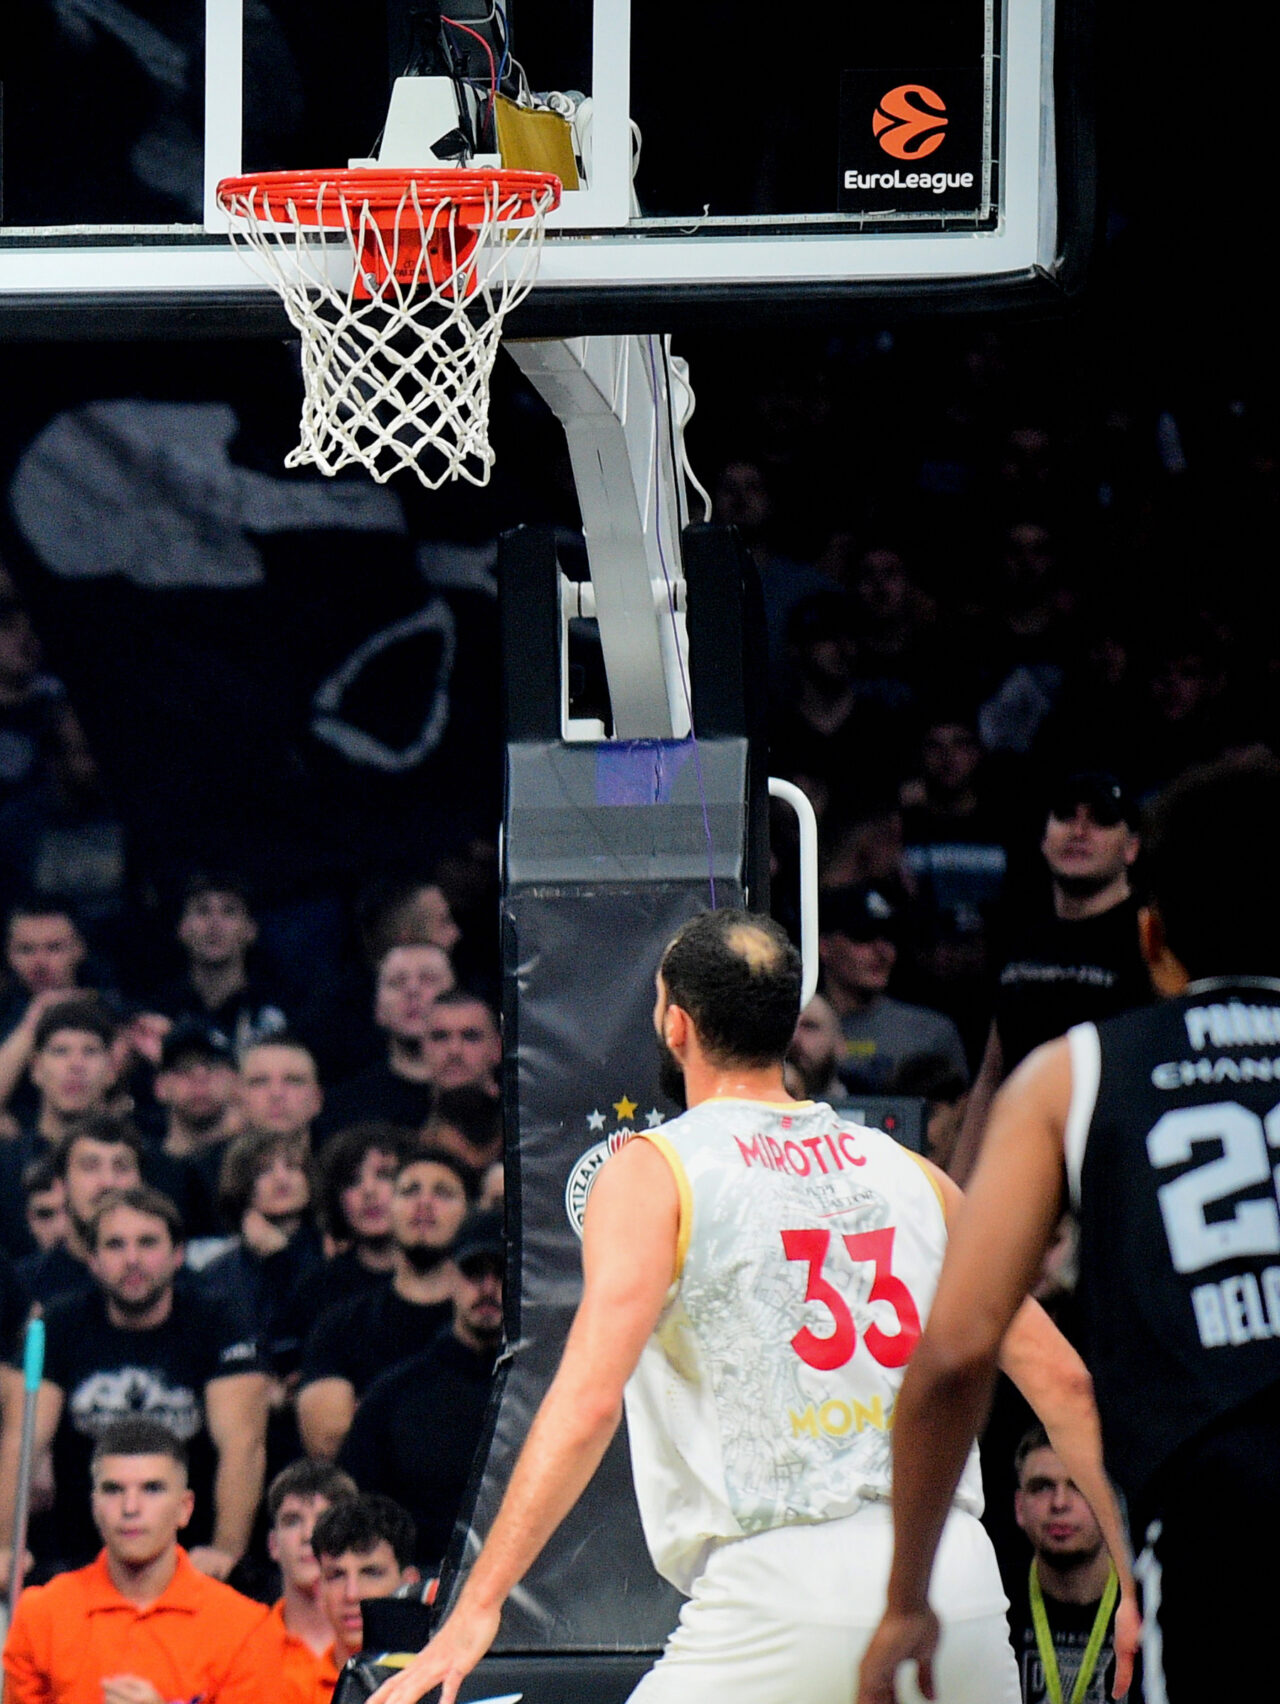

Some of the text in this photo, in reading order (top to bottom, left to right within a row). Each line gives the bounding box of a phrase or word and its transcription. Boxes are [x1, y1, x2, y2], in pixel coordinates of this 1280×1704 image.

[844, 169, 974, 194] EuroLeague
[1151, 1056, 1280, 1090] CHAN
[1146, 1101, 1280, 1274] 2
[780, 1226, 923, 1371] 33
[786, 1394, 899, 1439] MON
